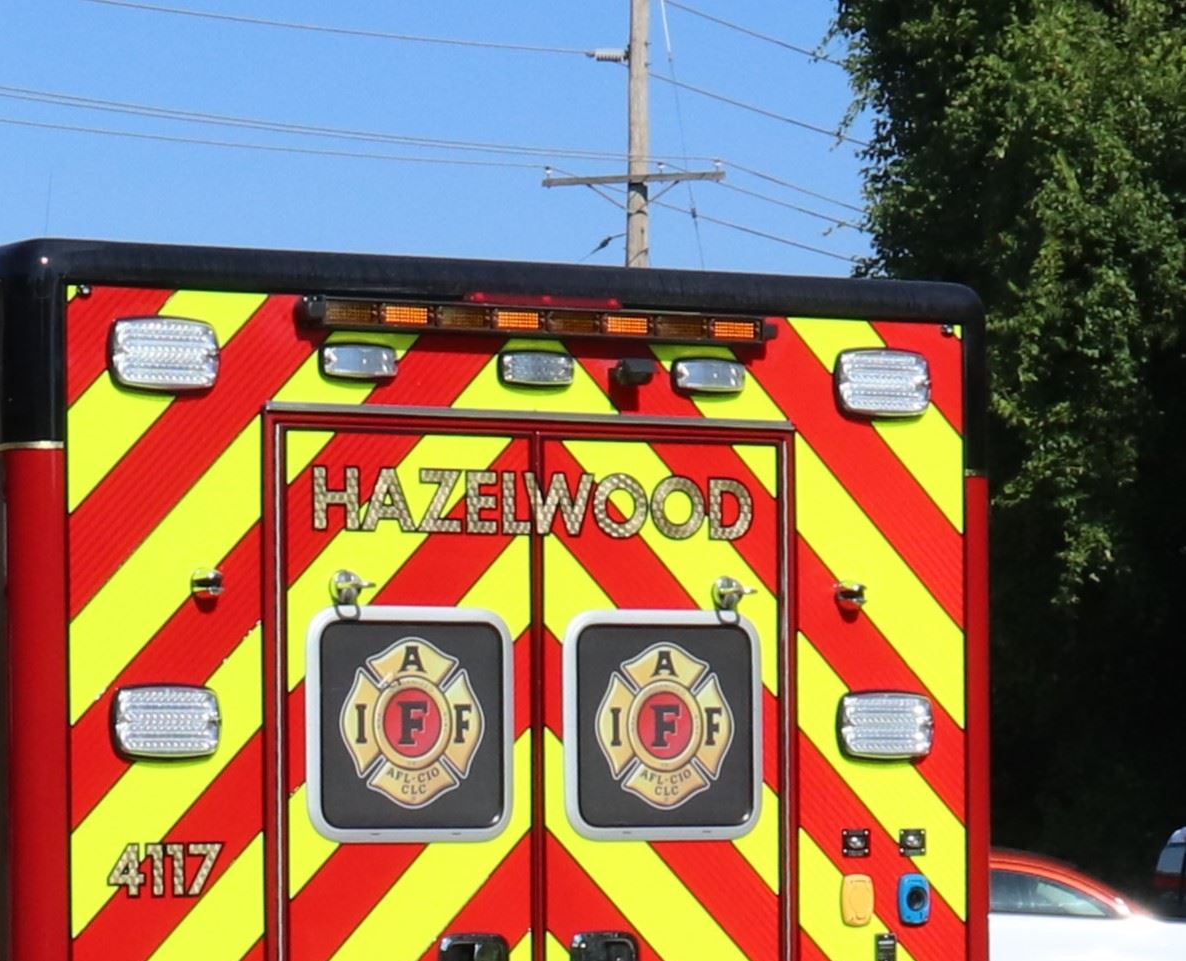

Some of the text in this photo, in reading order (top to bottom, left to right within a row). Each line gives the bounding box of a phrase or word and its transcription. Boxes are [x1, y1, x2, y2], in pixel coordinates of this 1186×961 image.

[311, 464, 754, 541] HAZELWOOD
[398, 646, 427, 673] A
[652, 650, 677, 676] A
[397, 700, 430, 747] F
[453, 703, 472, 744] F
[651, 703, 682, 748] F
[704, 707, 722, 747] F
[401, 784, 427, 796] CLC
[654, 784, 680, 797] CLC
[107, 842, 224, 898] 4117
